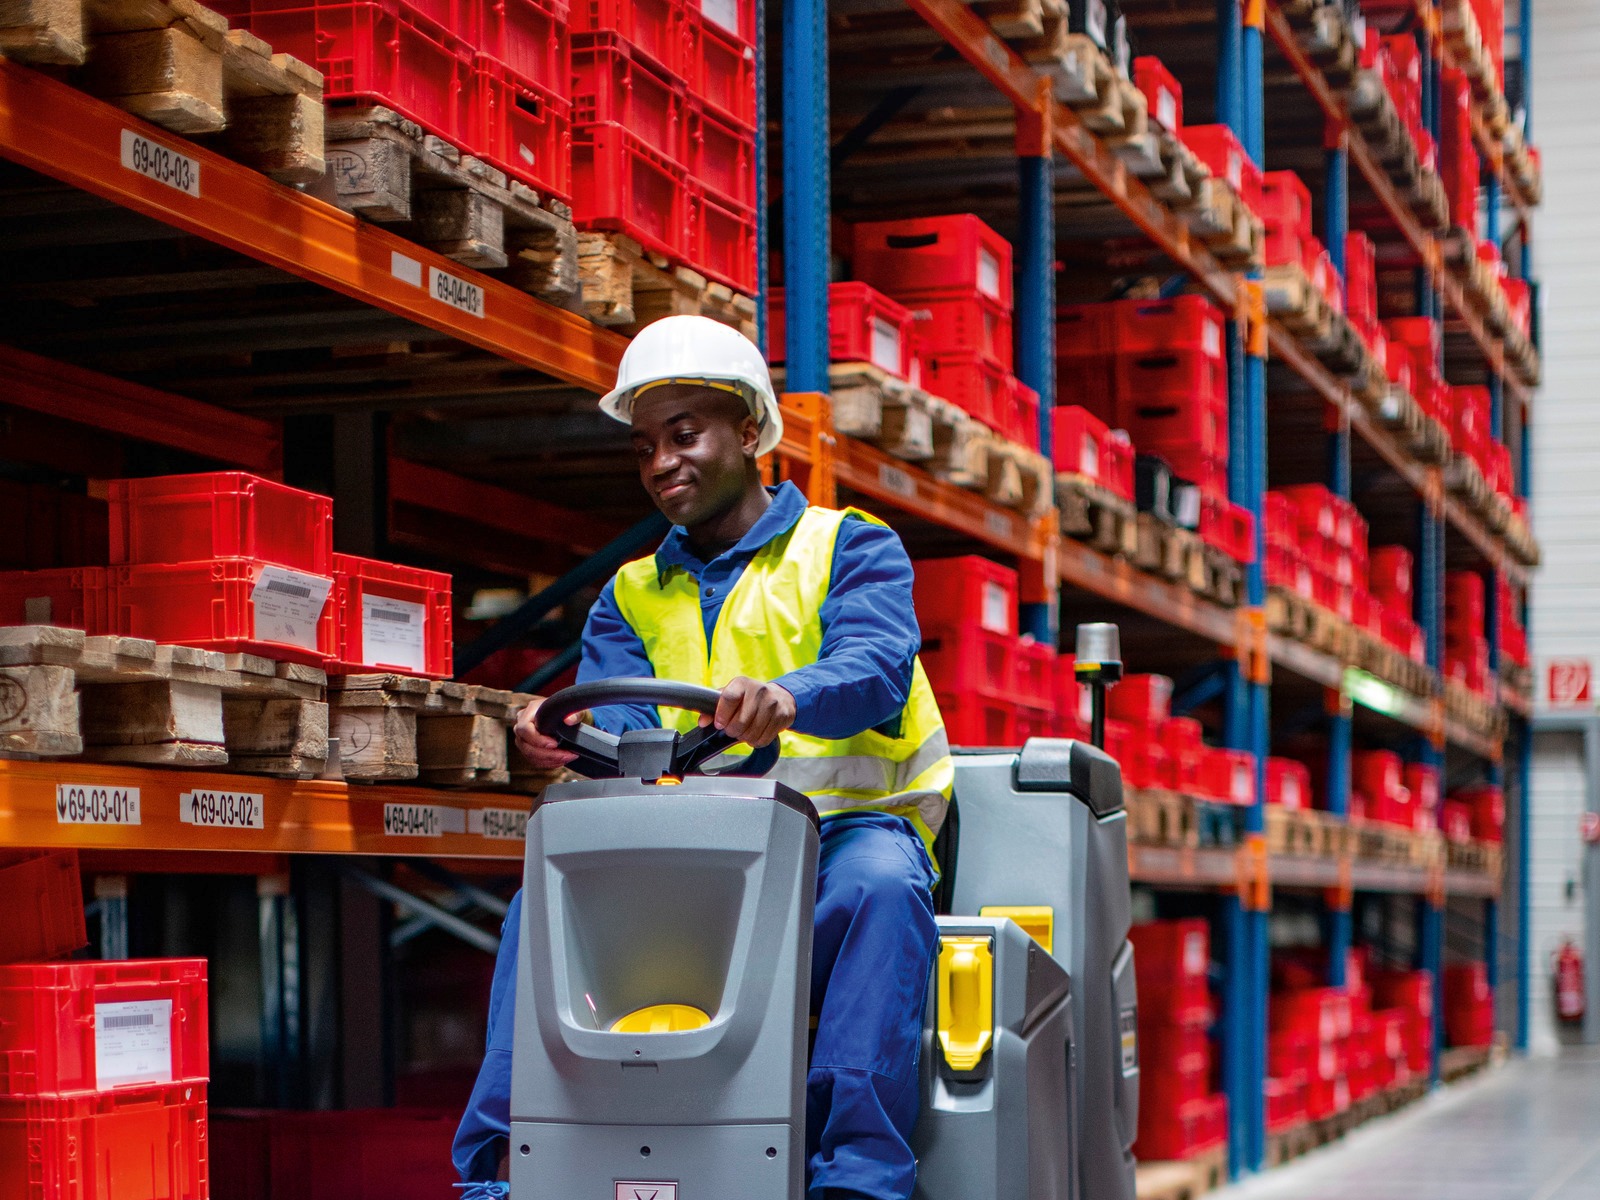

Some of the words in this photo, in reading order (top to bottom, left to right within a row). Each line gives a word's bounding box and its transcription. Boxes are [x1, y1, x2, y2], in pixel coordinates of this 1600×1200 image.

[133, 138, 189, 190] 69-03-03
[437, 272, 477, 312] 69-04-03
[68, 788, 129, 822] 69-03-01
[200, 793, 254, 826] 69-03-02
[392, 806, 434, 834] 69-04-01
